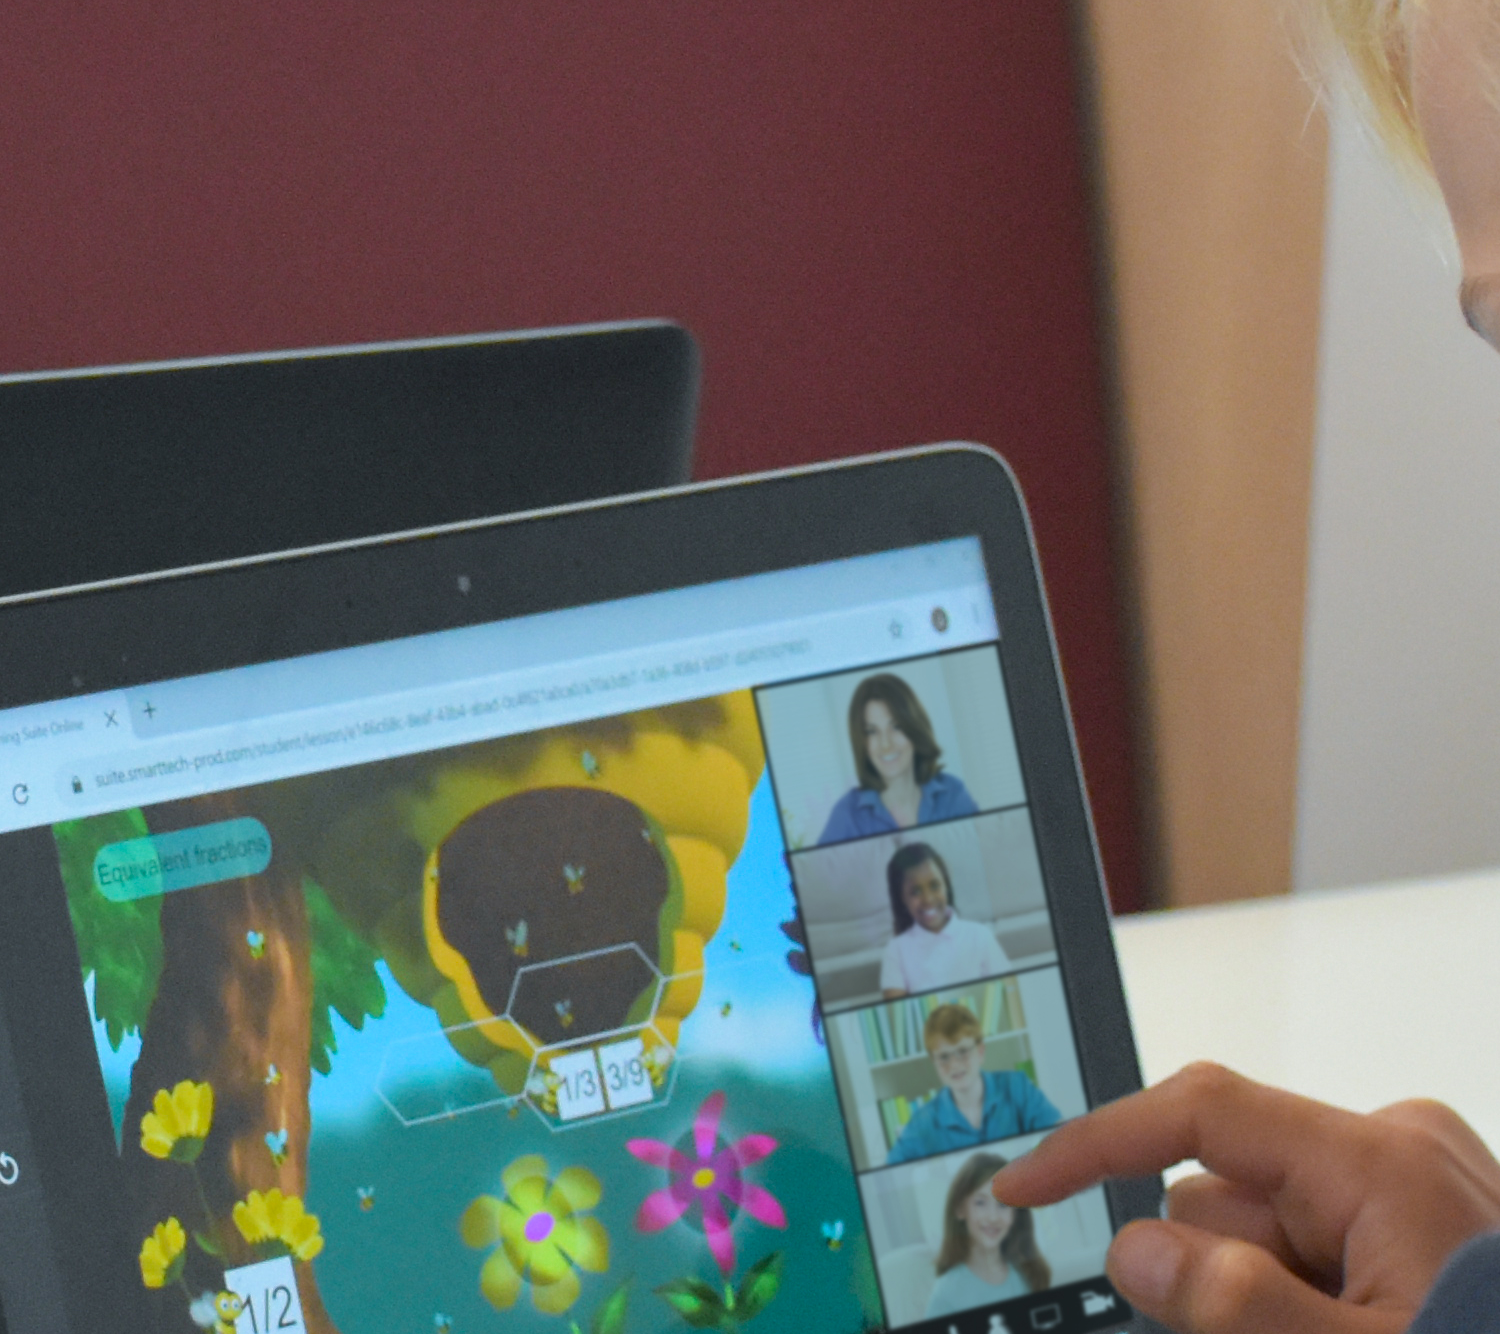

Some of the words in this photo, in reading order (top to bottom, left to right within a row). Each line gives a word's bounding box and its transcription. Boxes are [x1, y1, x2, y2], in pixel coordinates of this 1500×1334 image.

[21, 725, 49, 741] Suite
[50, 718, 84, 736] Online
[97, 848, 191, 887] Equivalent
[193, 836, 268, 866] fractions
[561, 1068, 598, 1102] 1/3
[606, 1057, 645, 1092] 3/9
